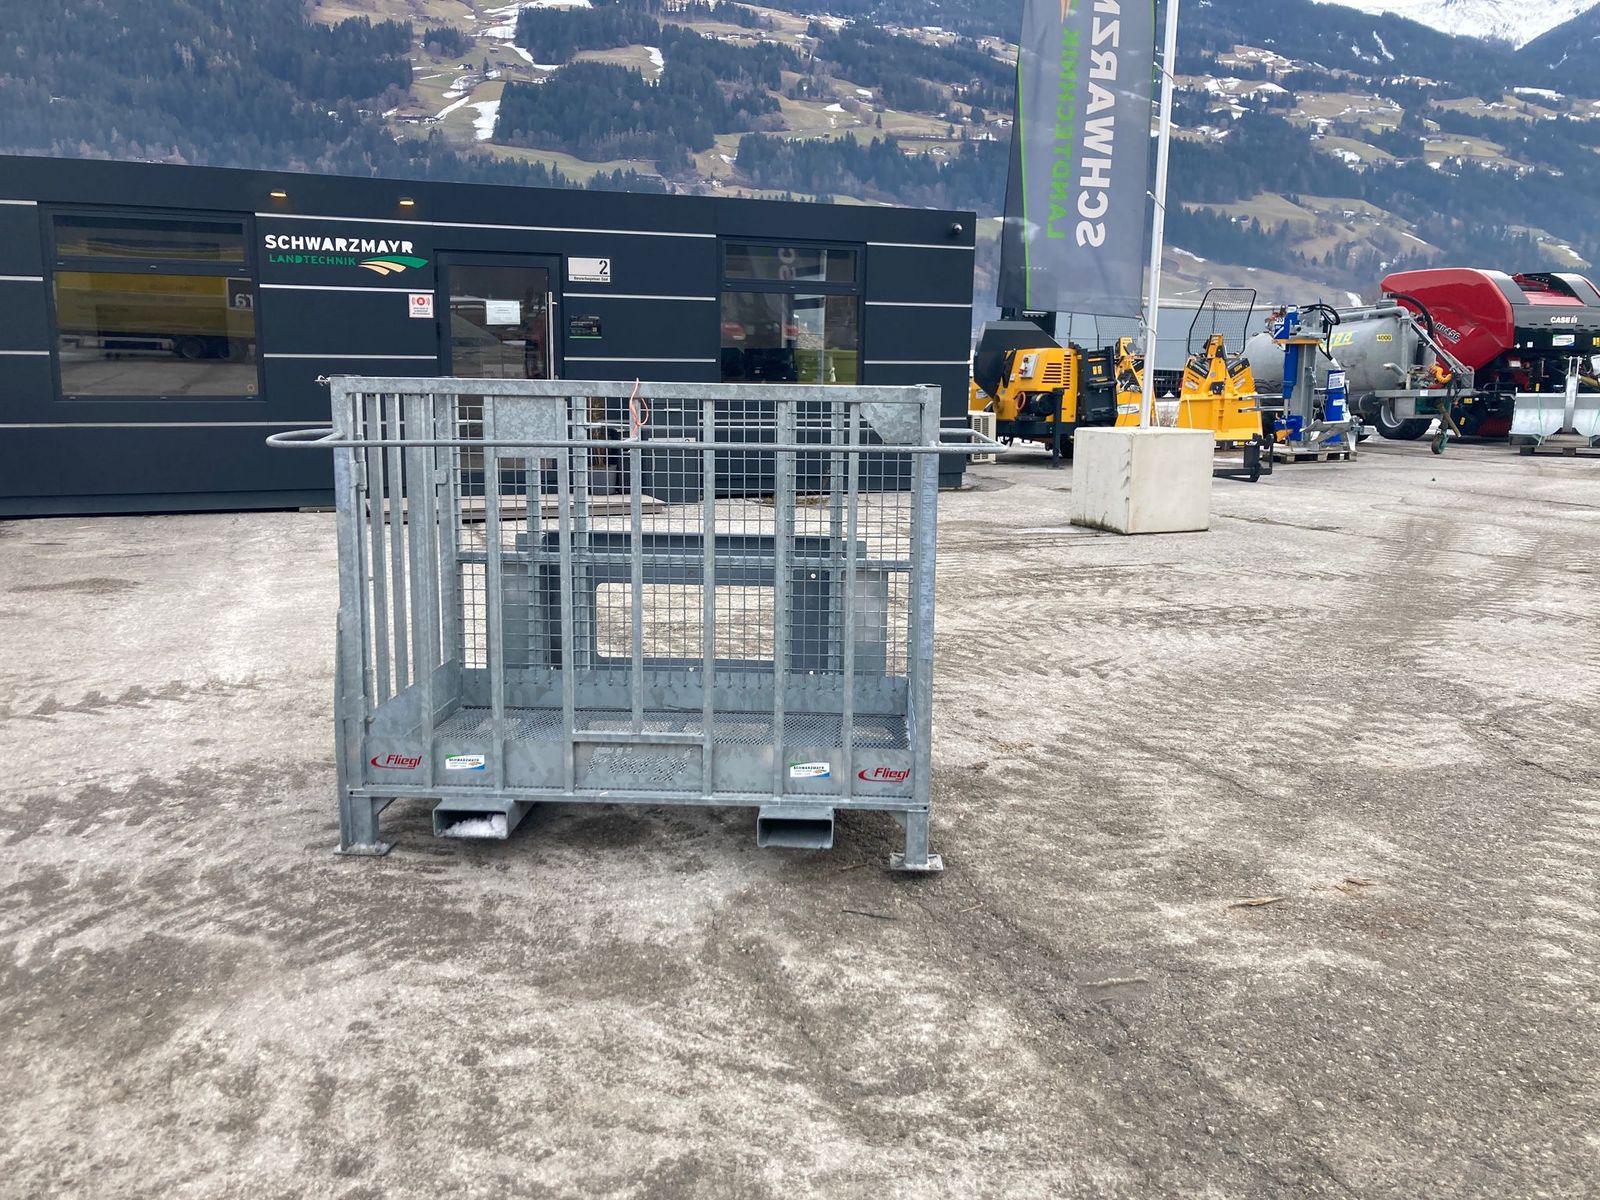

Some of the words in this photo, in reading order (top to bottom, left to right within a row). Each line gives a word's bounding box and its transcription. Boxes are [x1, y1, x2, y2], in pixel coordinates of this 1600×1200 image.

[264, 234, 413, 254] SCHWARZMAYR
[269, 254, 356, 266] LANDTECHNIK
[599, 260, 608, 275] 2
[1550, 316, 1571, 324] CASE
[386, 754, 422, 768] Fliegl
[873, 767, 911, 781] Fliegl
